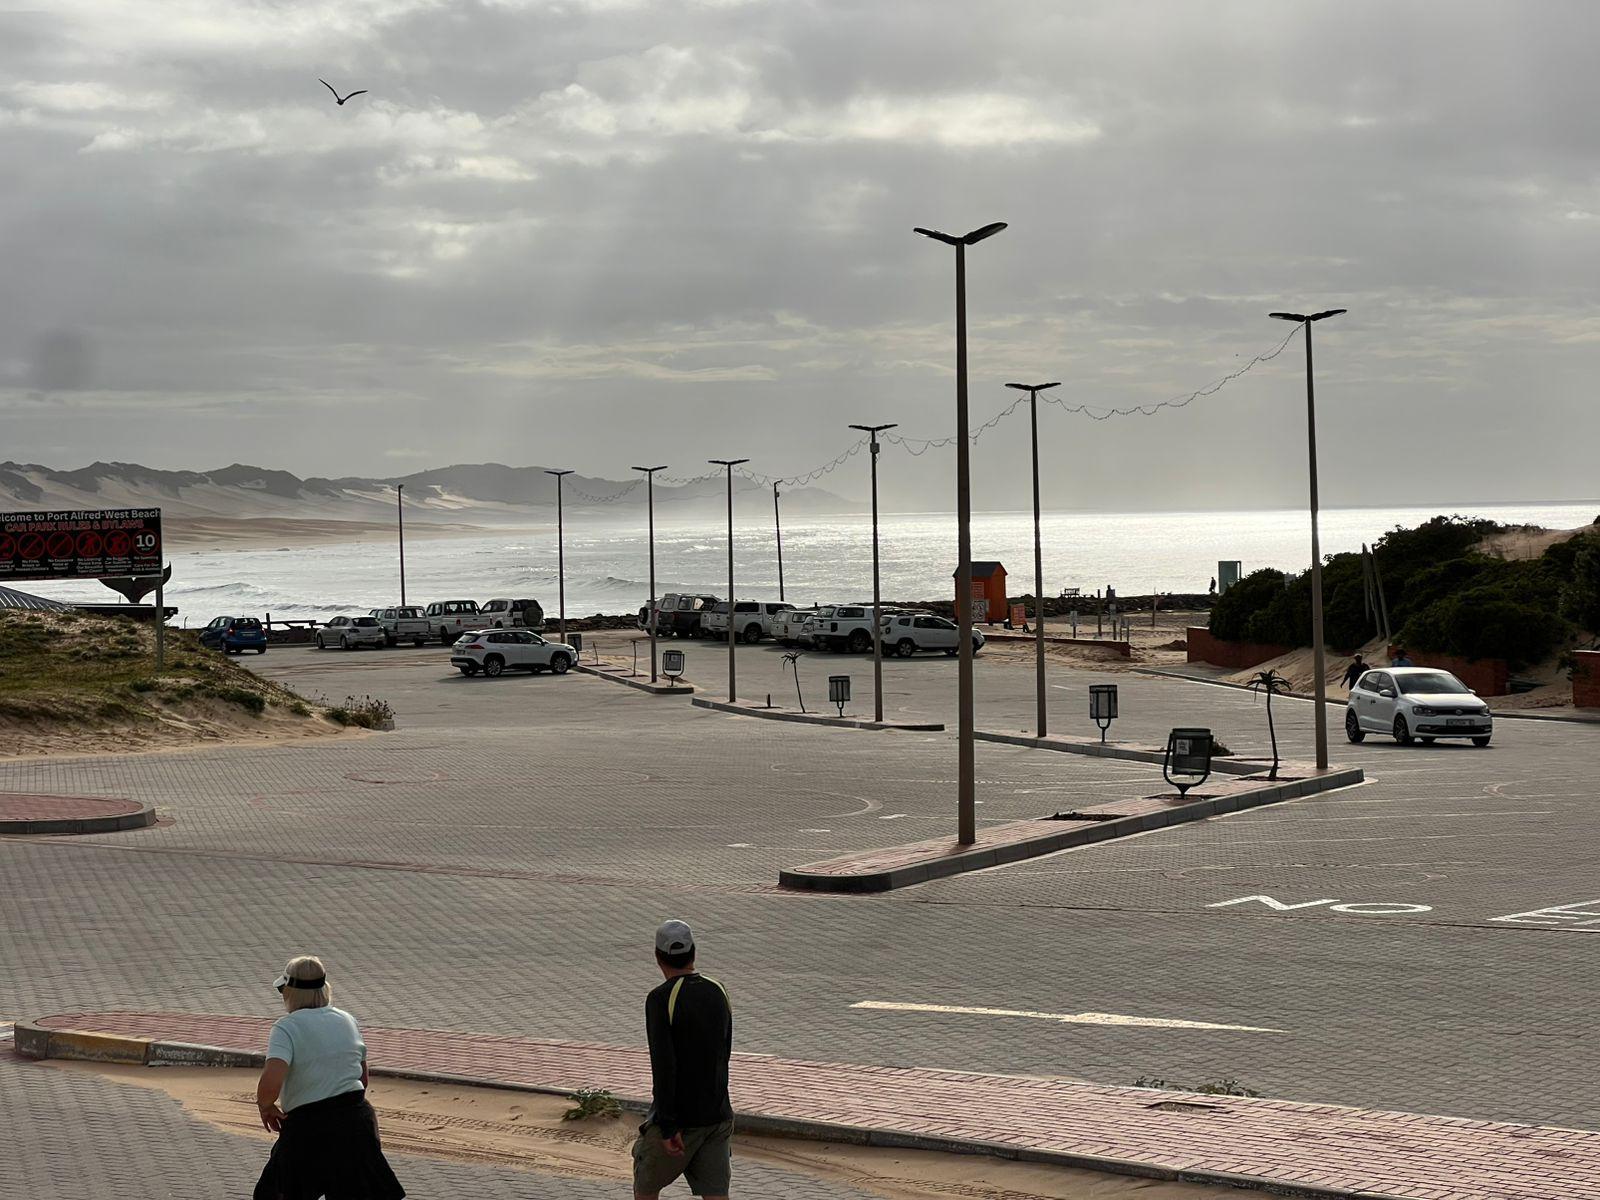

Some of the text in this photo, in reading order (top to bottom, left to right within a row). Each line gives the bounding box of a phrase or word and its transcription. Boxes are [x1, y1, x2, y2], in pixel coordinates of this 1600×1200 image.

[0, 513, 32, 522] lcome
[34, 513, 45, 521] to
[47, 512, 68, 520] Port
[131, 509, 160, 519] Beach
[5, 522, 27, 533] CAR
[29, 521, 57, 532] PARK
[57, 520, 91, 531] RULES
[136, 534, 155, 547] 10
[1206, 896, 1433, 913] NO
